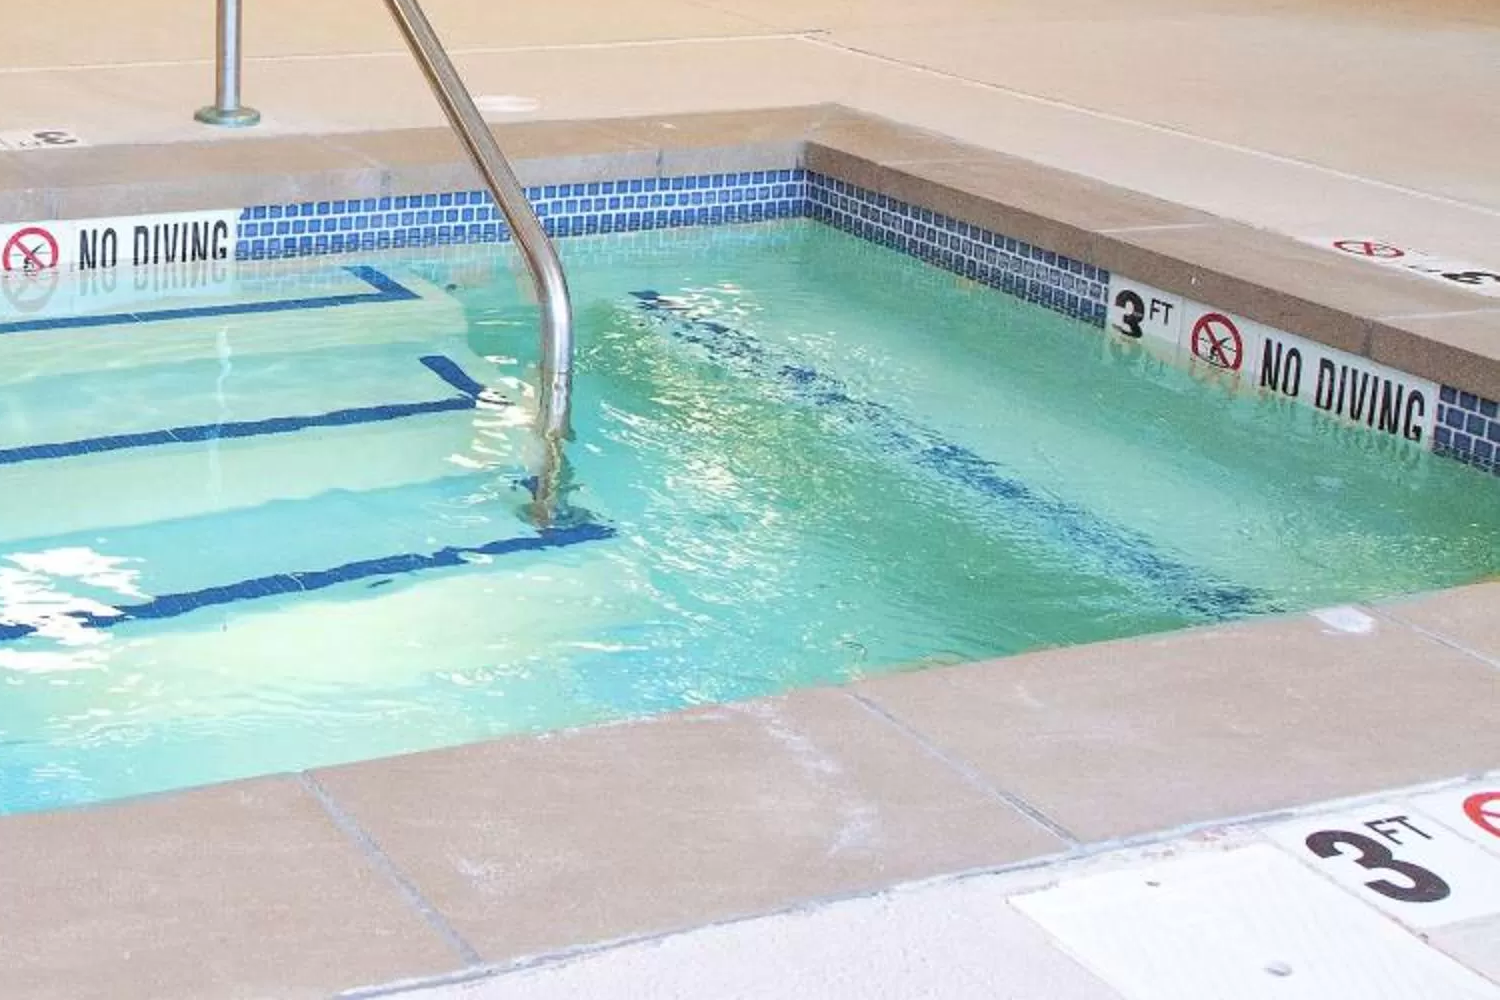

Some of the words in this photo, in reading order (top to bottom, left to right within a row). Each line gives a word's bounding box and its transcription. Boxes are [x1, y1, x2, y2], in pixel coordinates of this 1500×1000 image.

[79, 227, 118, 270] NO
[133, 219, 228, 266] DIVING
[1115, 290, 1145, 338] 3
[1150, 299, 1174, 325] FT
[1261, 338, 1301, 397] NO
[1315, 357, 1425, 442] DIVING
[1364, 815, 1432, 845] FT
[1305, 830, 1451, 902] 3
